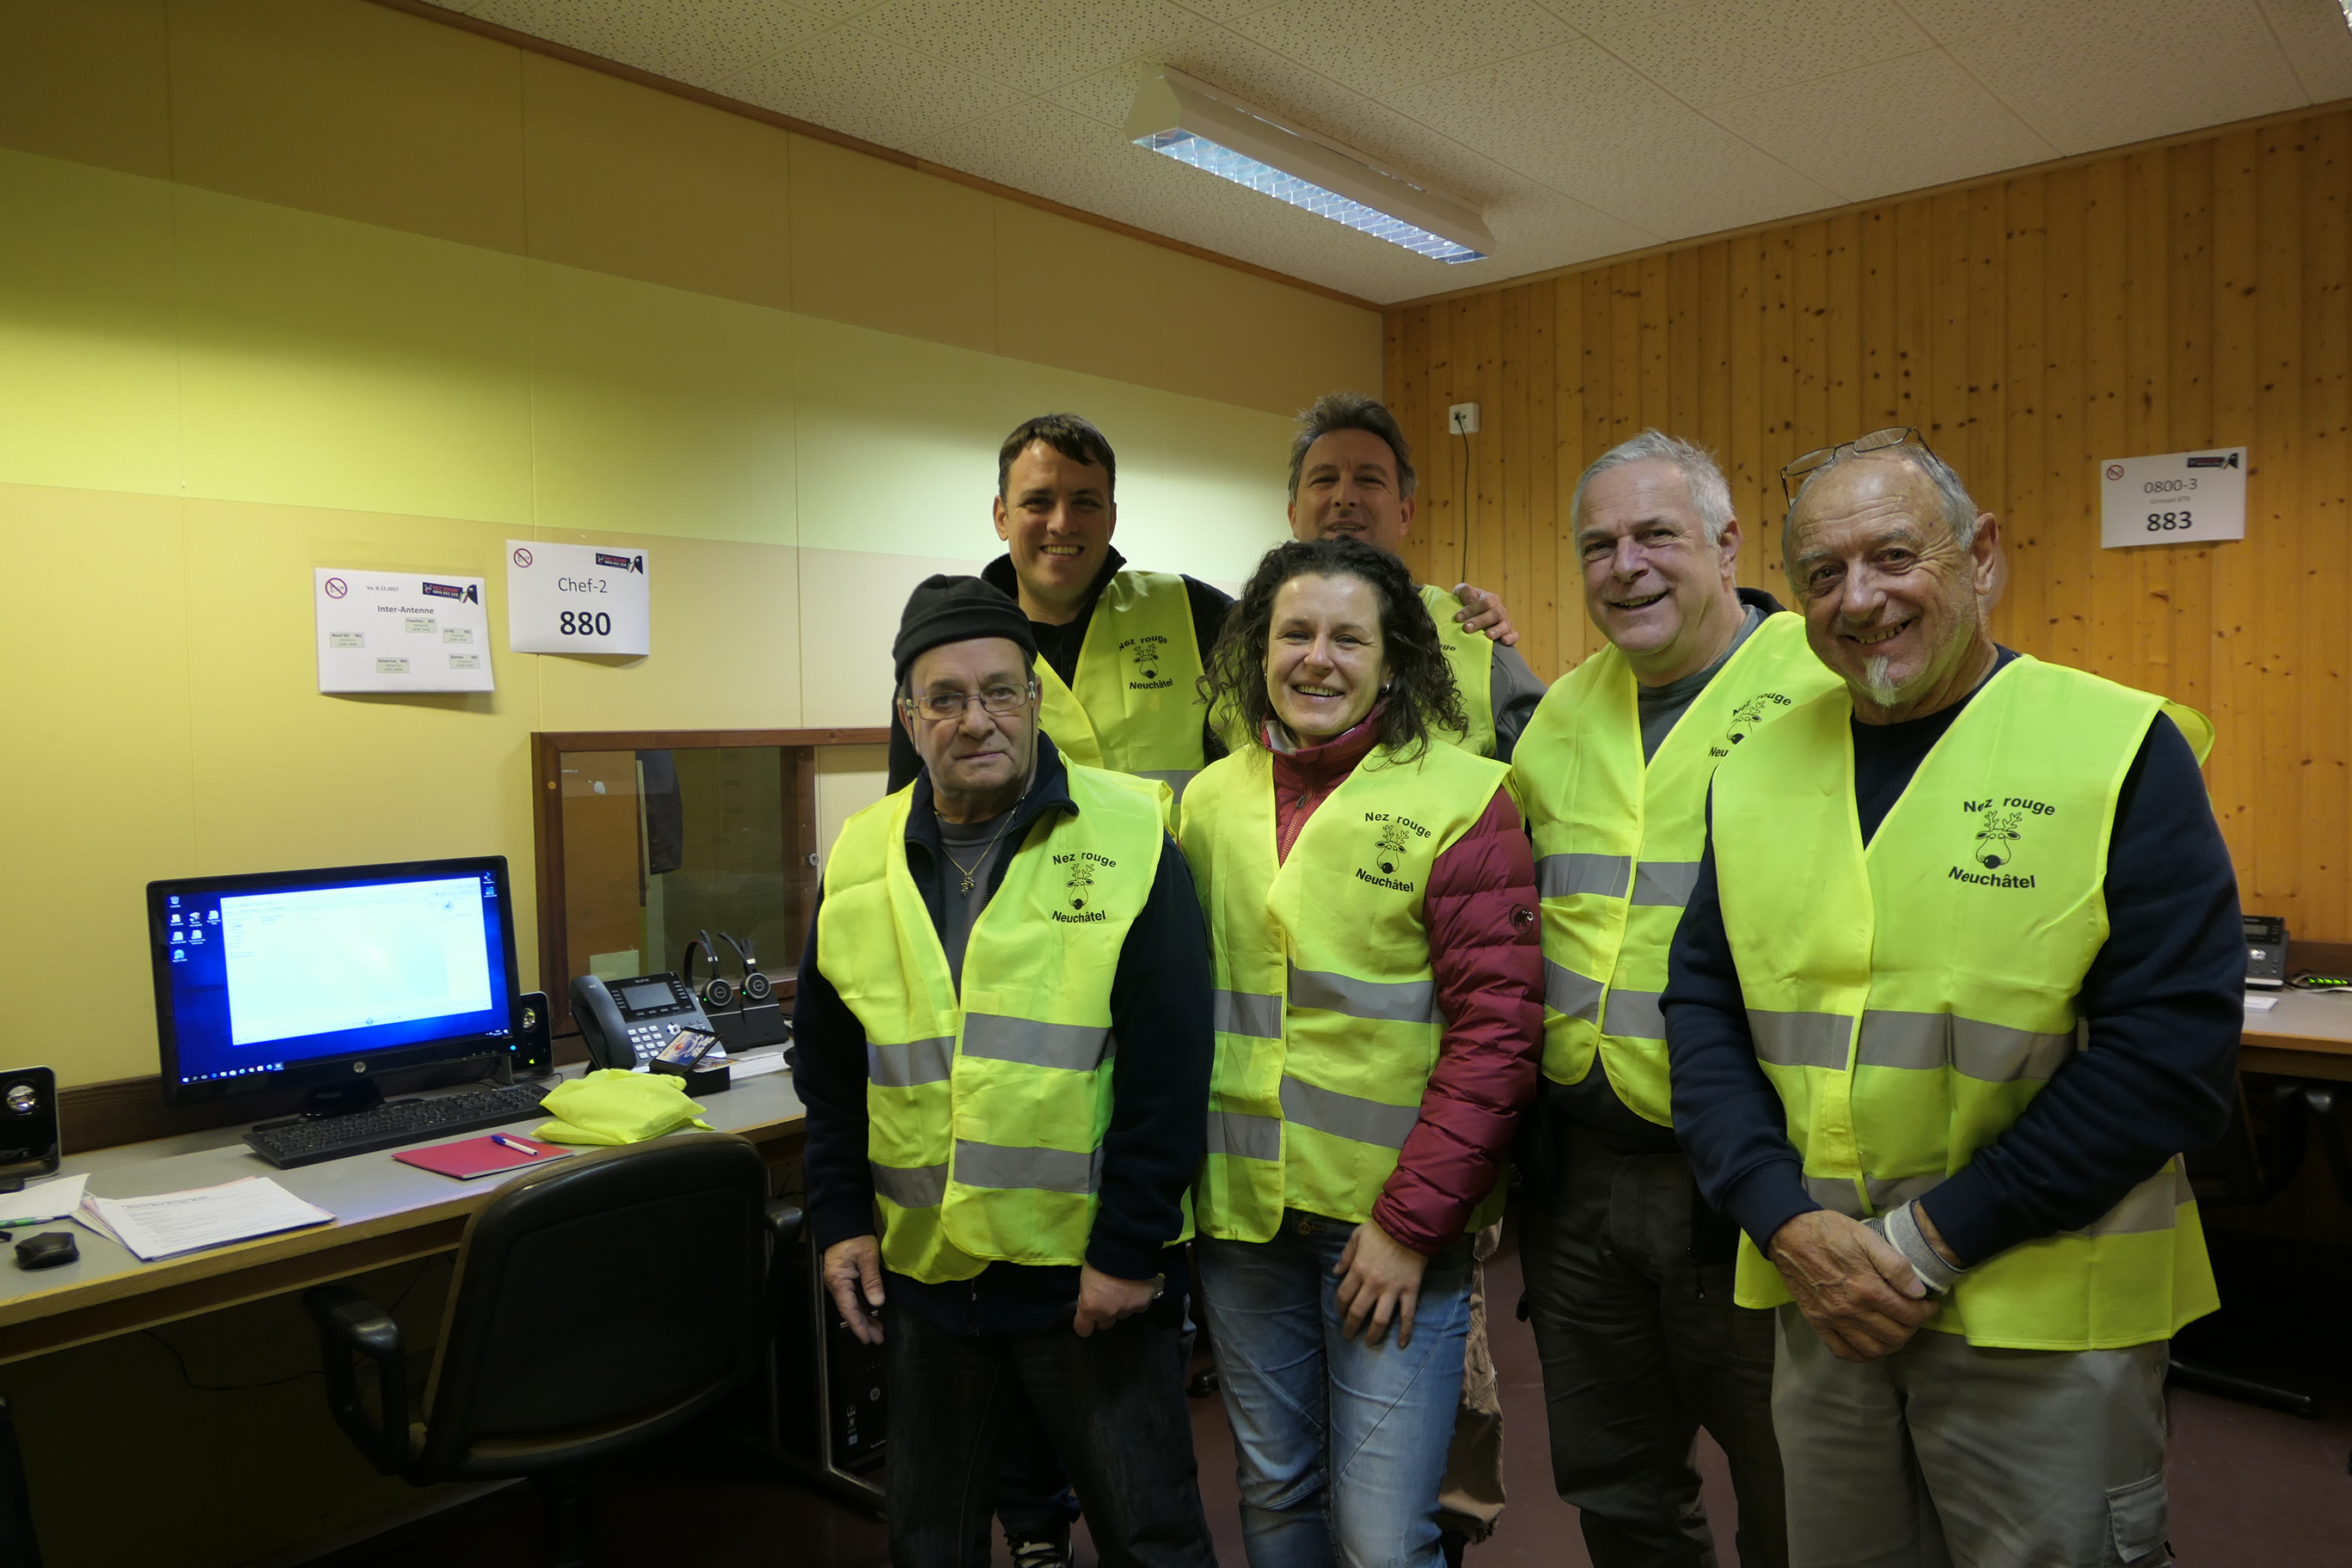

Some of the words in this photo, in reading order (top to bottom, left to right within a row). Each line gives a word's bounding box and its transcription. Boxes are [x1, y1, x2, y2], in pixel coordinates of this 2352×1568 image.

[2144, 478, 2198, 493] 0800-3
[2147, 511, 2192, 531] 883
[558, 577, 608, 594] Chef-2
[377, 604, 435, 615] Inter-Antenne
[560, 611, 611, 636] 880
[1140, 635, 1168, 645] rouge
[1130, 677, 1173, 689] Neuchâtel
[1755, 692, 1792, 706] rouge
[1708, 747, 1730, 757] Neu
[1963, 799, 1994, 812] Nez
[2003, 798, 2056, 816] rouge
[1365, 812, 1389, 822] Nez
[1396, 816, 1431, 838] rouge
[1052, 854, 1075, 866] Nez
[1081, 852, 1117, 868] rouge
[1356, 867, 1414, 892] Neuchâtel
[1948, 866, 2037, 889] Neuchâtel
[1051, 910, 1106, 923] Neuchâtel
